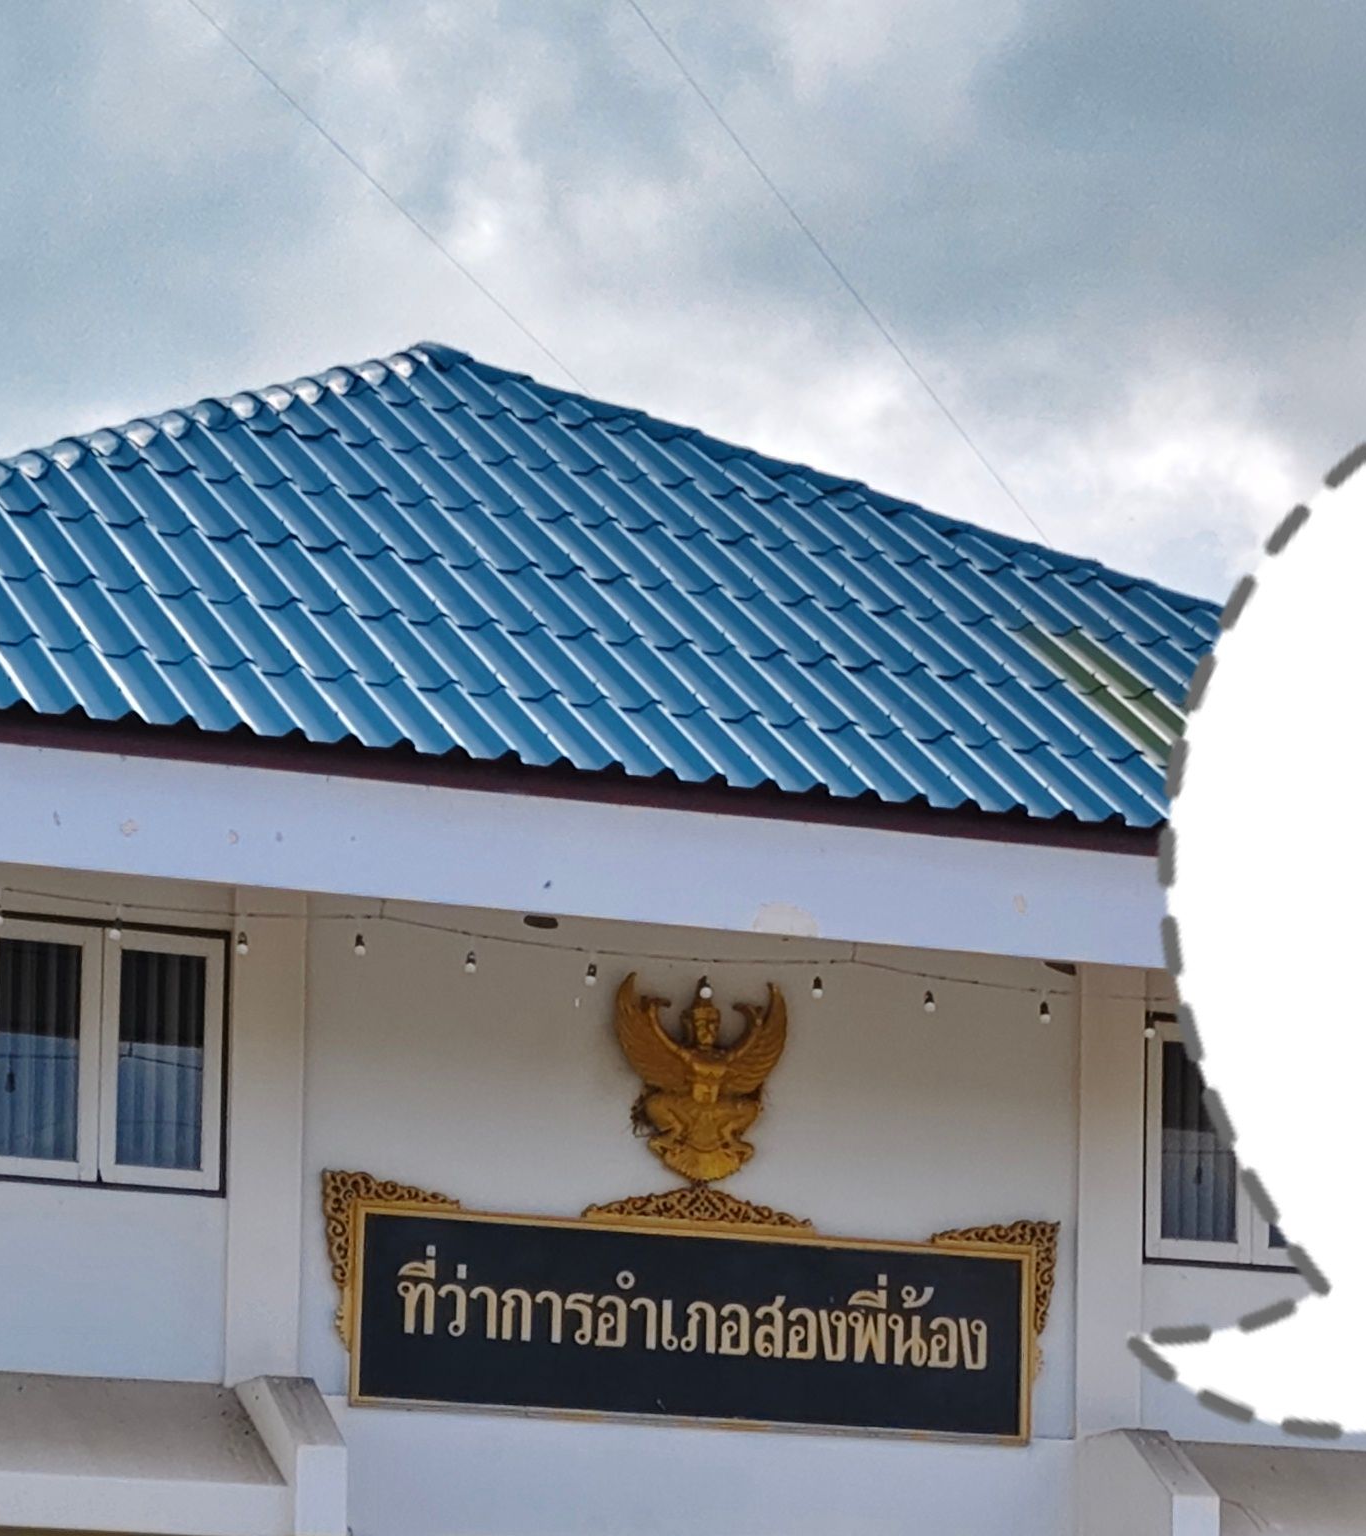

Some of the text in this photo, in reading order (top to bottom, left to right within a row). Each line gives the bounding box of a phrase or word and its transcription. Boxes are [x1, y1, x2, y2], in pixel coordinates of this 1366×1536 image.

[397, 1244, 988, 1371] ที่ว่าการอำเภอสองพี่น้อง
